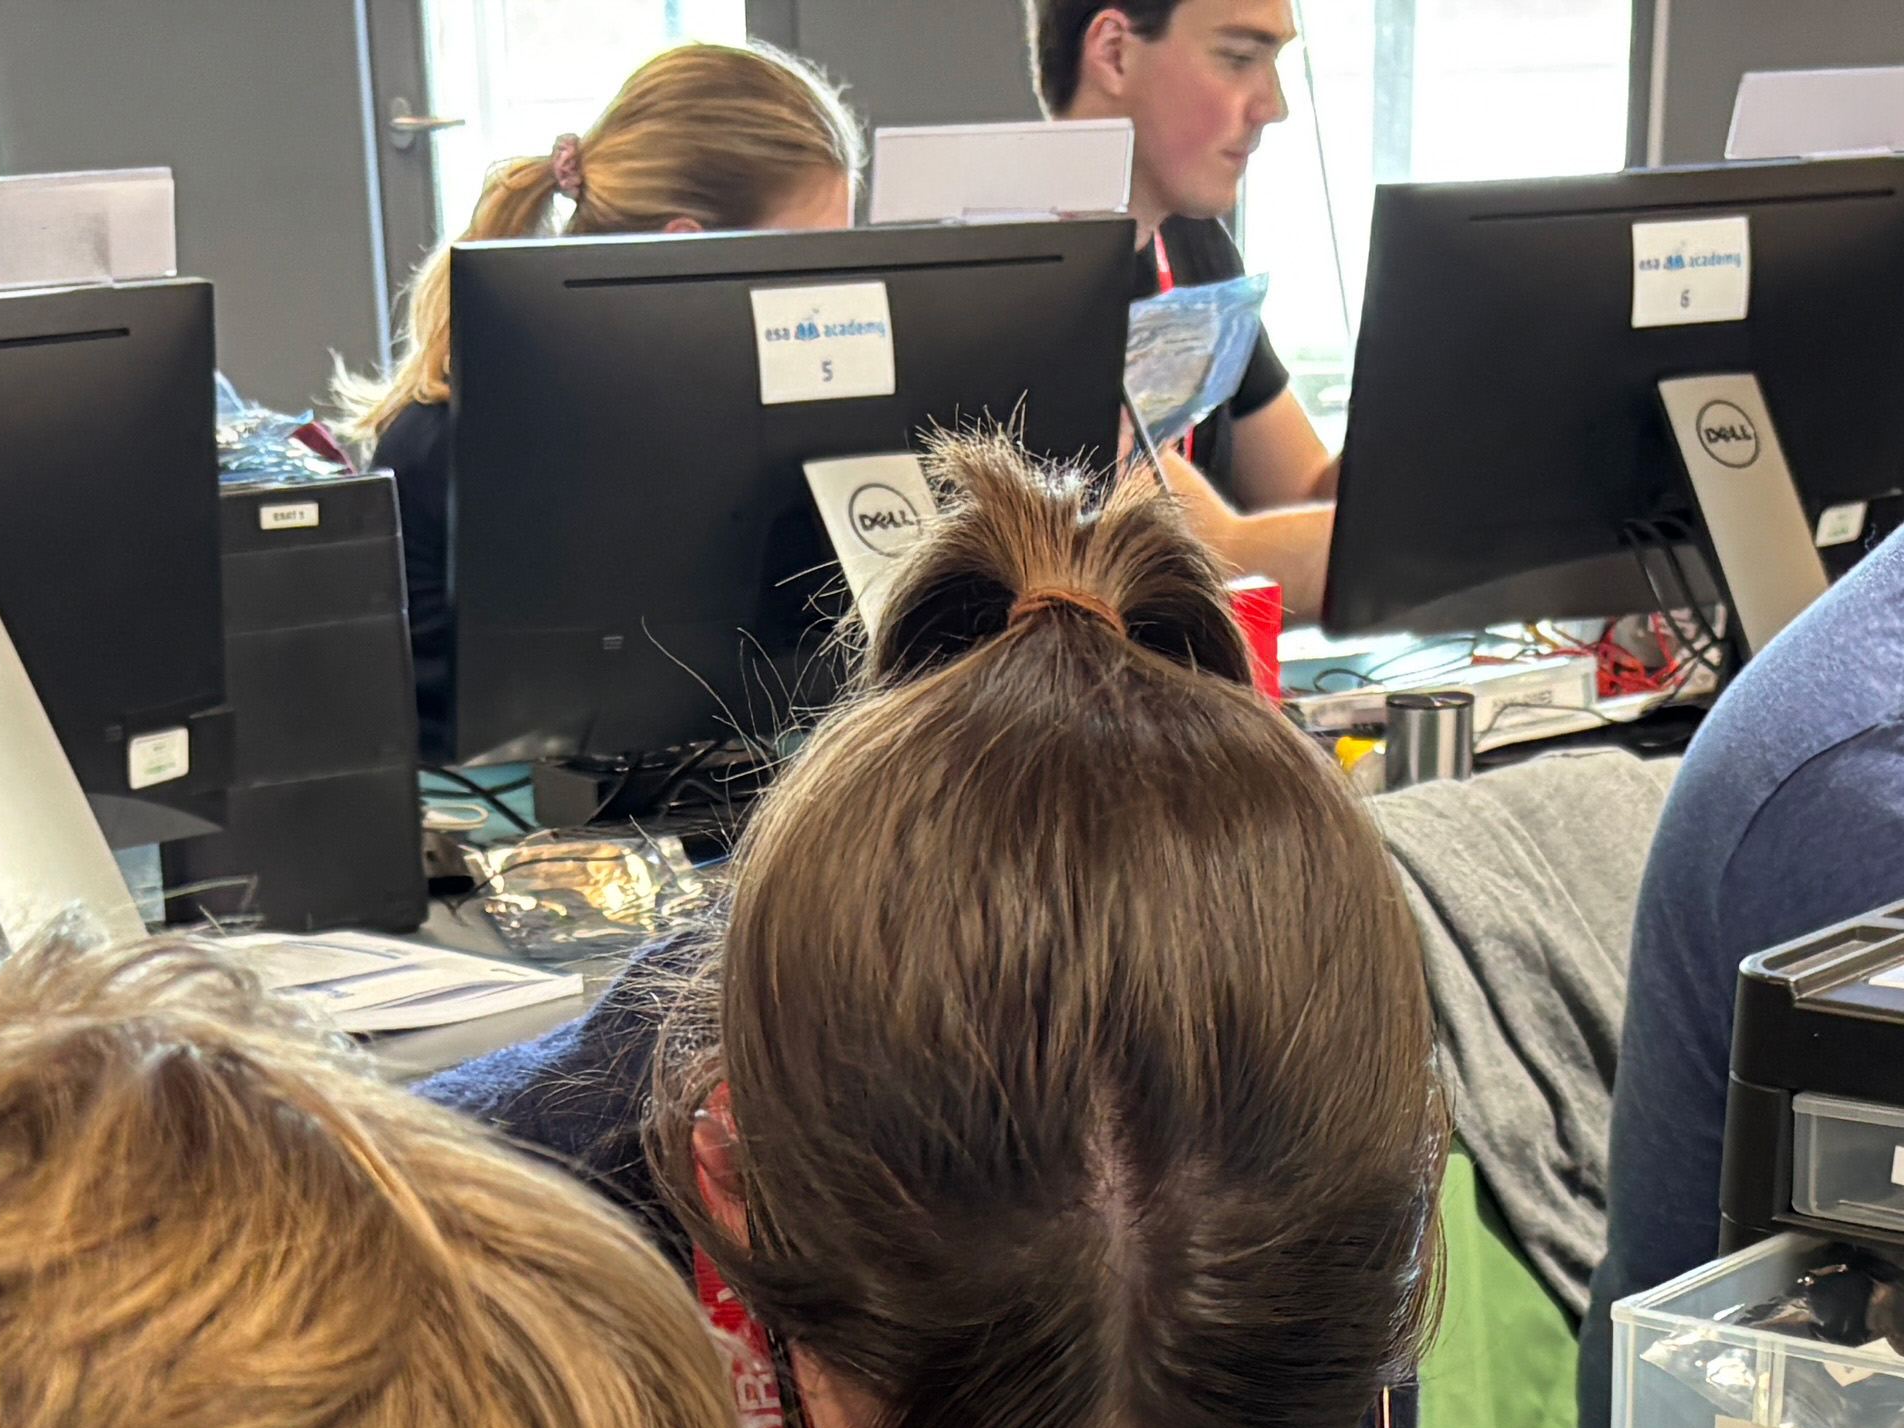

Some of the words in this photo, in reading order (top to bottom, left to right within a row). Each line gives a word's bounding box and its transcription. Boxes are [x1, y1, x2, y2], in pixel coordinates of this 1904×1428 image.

[765, 326, 791, 342] esa
[824, 319, 886, 338] academy
[821, 360, 833, 382] 5
[1704, 424, 1752, 444] DELL
[859, 511, 915, 531] DELL
